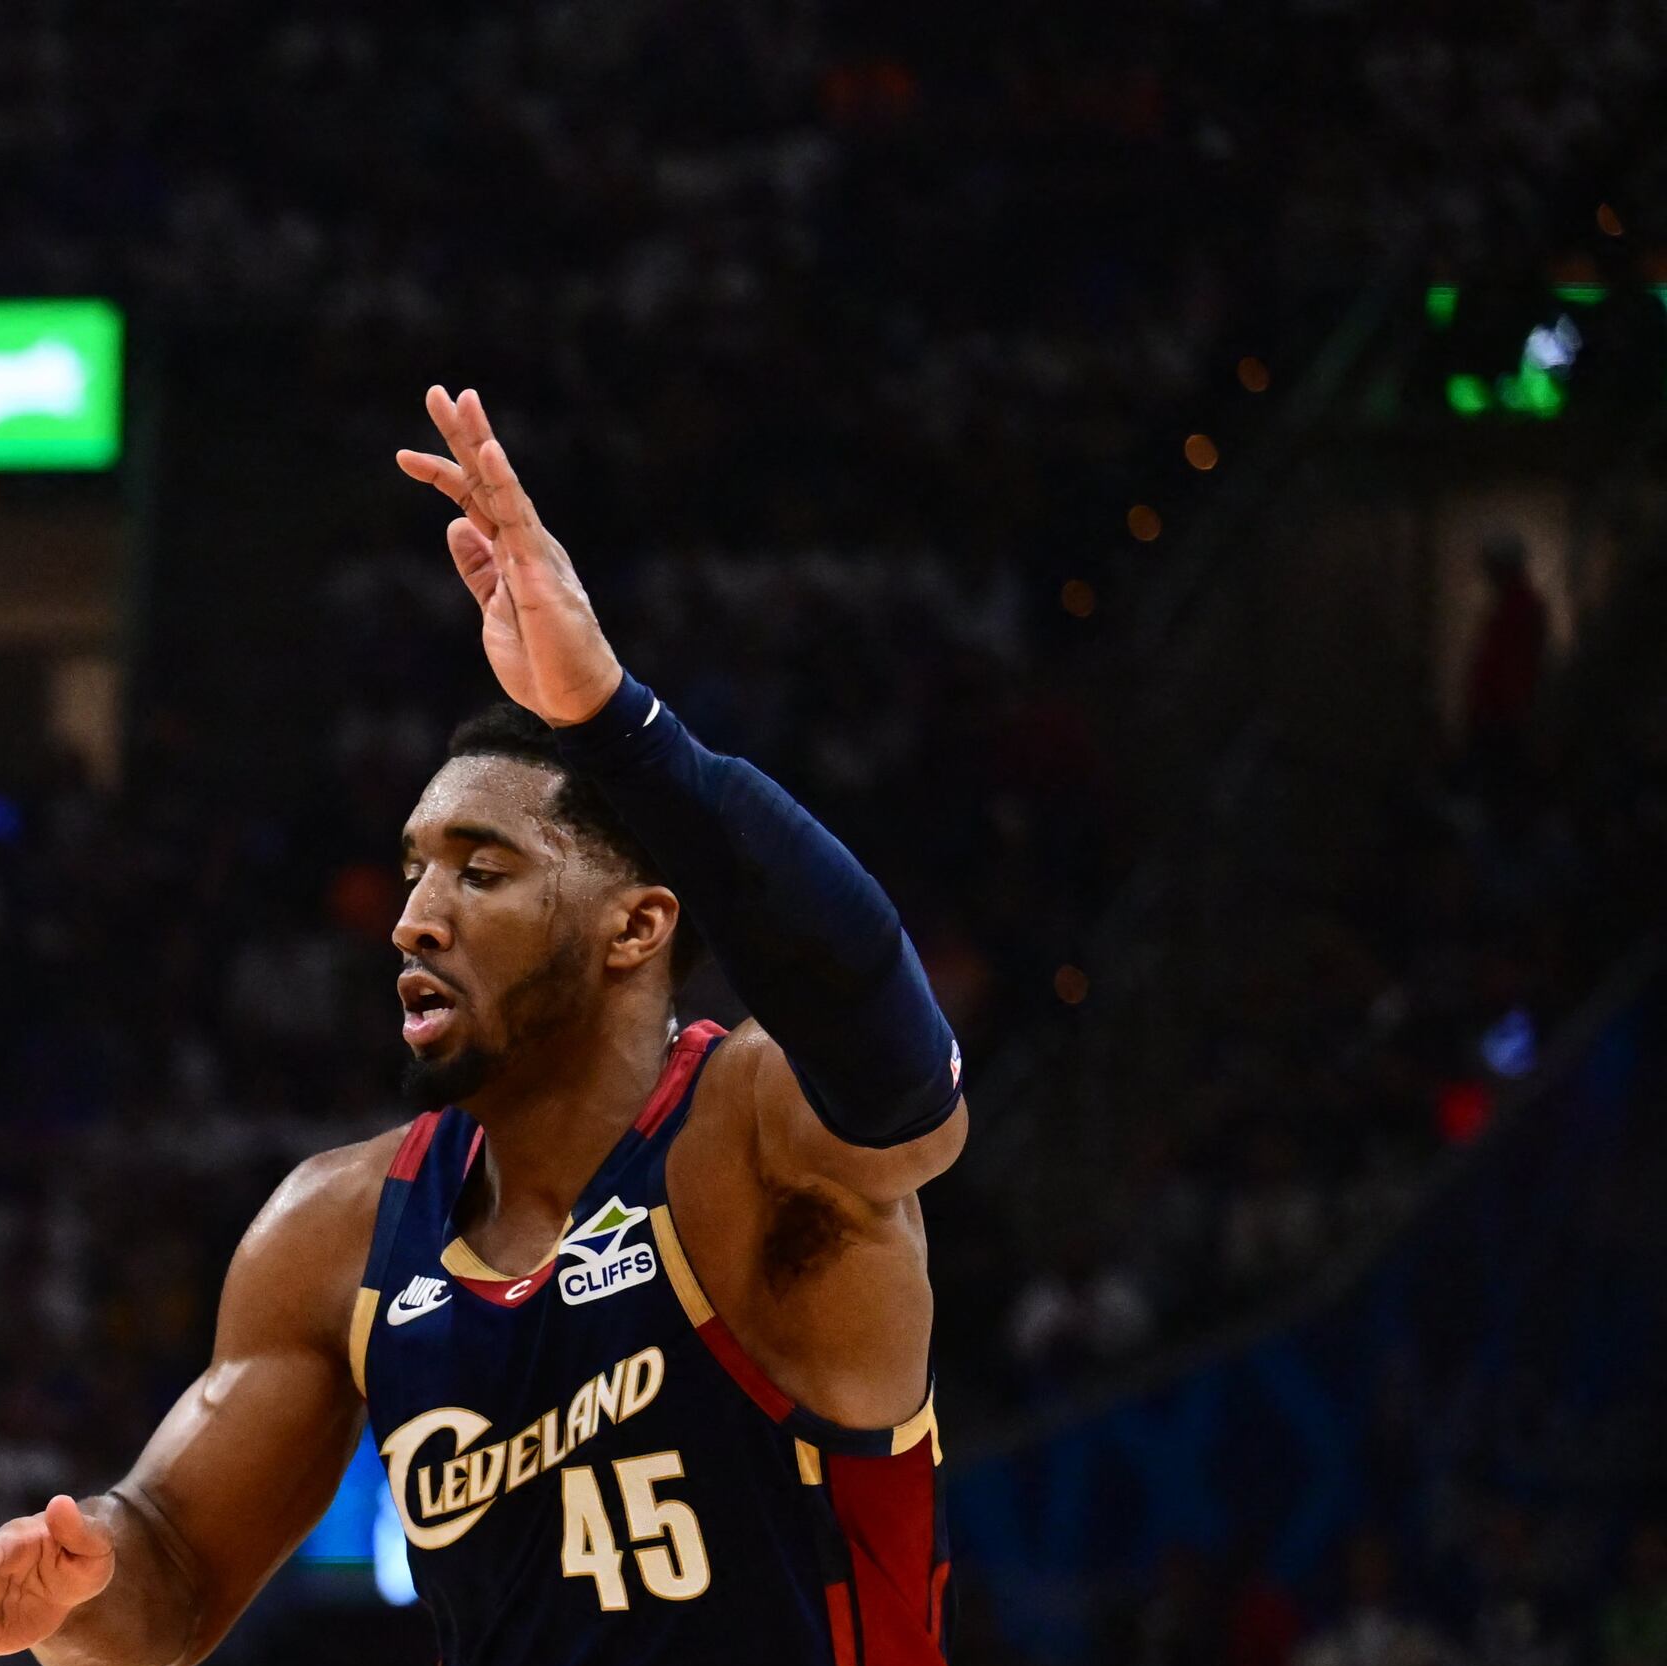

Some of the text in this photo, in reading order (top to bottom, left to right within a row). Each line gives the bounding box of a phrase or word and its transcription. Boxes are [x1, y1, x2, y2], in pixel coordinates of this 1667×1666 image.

[400, 1275, 448, 1307] NIKE
[564, 1251, 653, 1297] CLIFFS
[380, 1346, 665, 1549] CLEVELAND
[561, 1450, 711, 1612] 45
